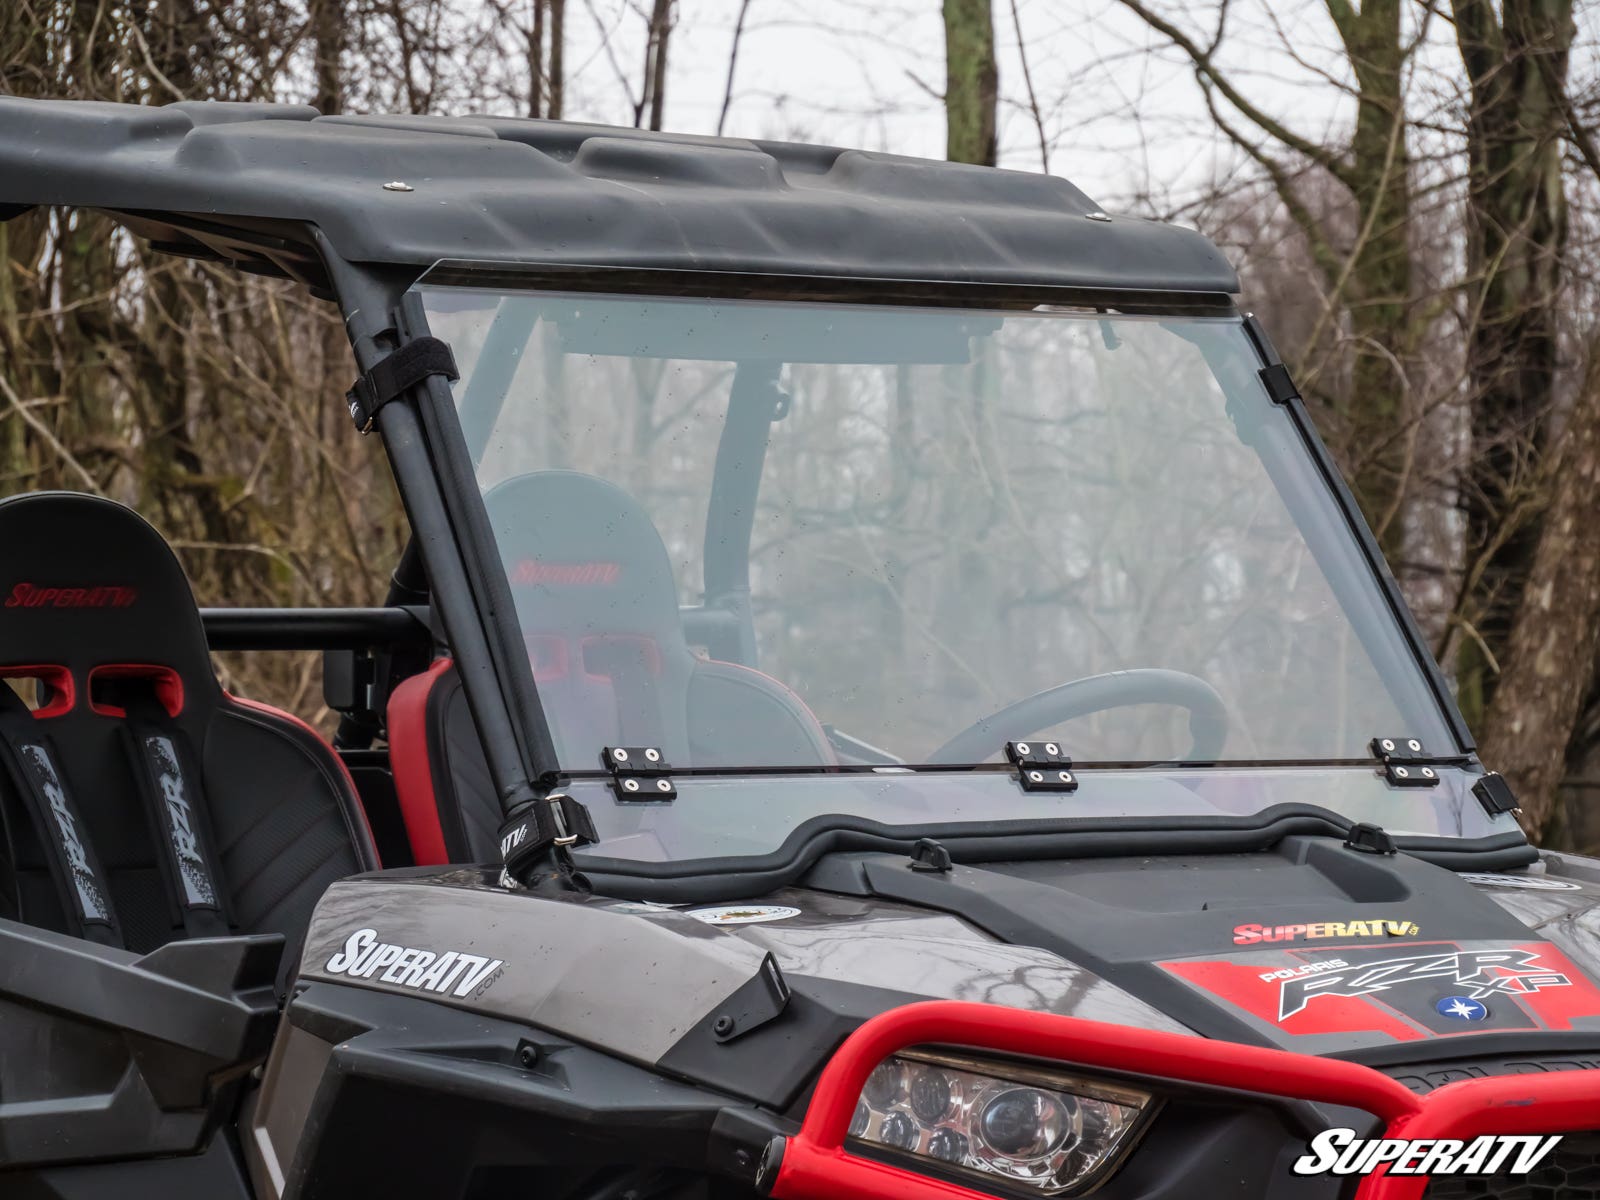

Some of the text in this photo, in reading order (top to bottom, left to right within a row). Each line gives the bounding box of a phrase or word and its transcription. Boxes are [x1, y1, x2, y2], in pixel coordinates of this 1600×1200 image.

[43, 781, 95, 877] RZR
[160, 773, 203, 863] RZR
[325, 928, 504, 998] SUPERATV
[1232, 919, 1411, 945] SUPERATV
[1258, 958, 1350, 984] POLARIS
[1277, 950, 1574, 1023] RZR XP
